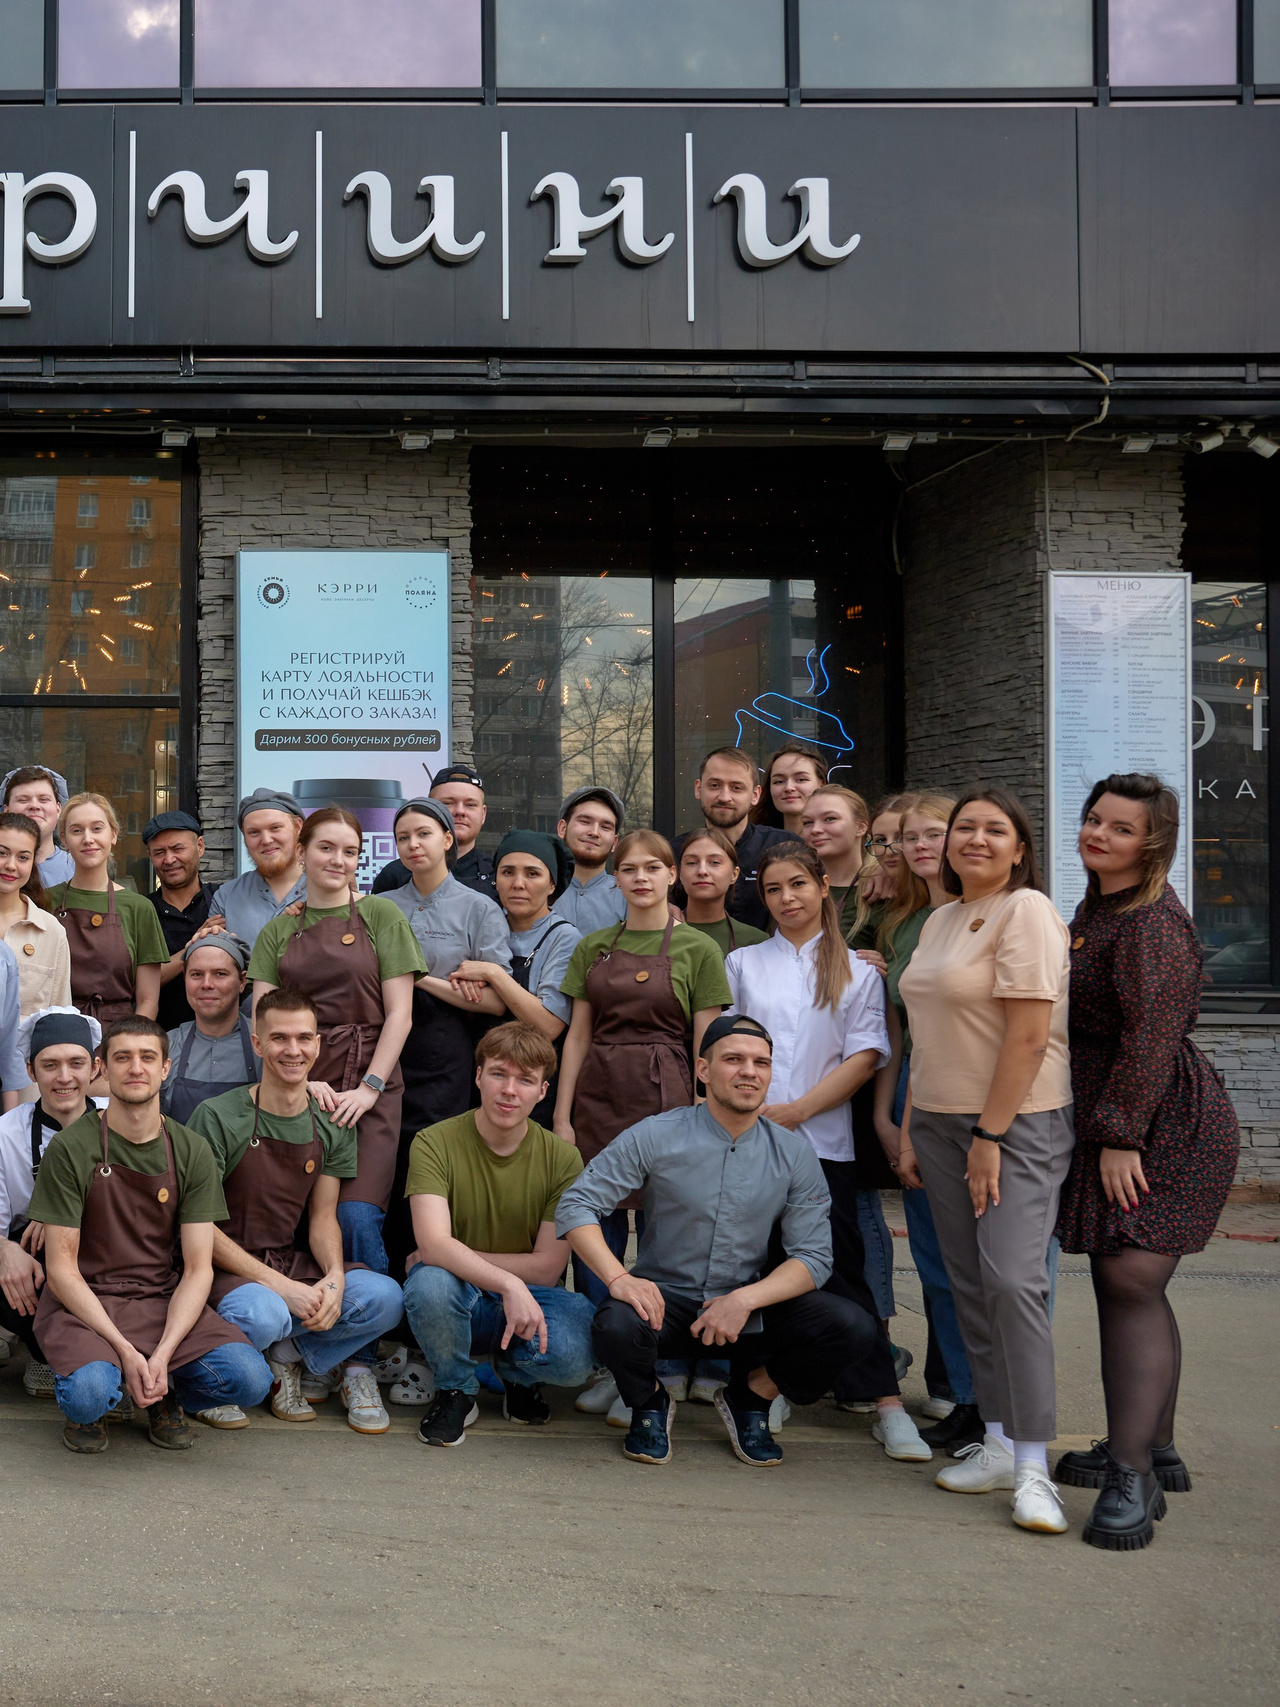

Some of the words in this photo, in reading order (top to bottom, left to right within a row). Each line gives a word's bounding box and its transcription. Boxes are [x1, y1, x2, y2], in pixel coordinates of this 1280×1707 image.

[317, 583, 377, 594] КЭРРИ
[1097, 580, 1141, 591] МЕНЮ
[290, 651, 405, 665] РЕГИСТРИРУЙ
[261, 670, 312, 683] КАРТУ
[317, 670, 434, 683] ЛОЯЛЬНОСТИ
[262, 688, 274, 701] И
[280, 686, 361, 701] ПОЛУЧАЙ
[368, 688, 432, 701] КЕШБЭК
[259, 706, 271, 719] С
[277, 706, 364, 720] КАЖДОГО
[369, 706, 437, 719] ЗАКАЗА!
[259, 734, 301, 747] Дарим
[304, 734, 328, 745] 300
[331, 733, 391, 748] бонусных
[393, 733, 437, 748] рублей
